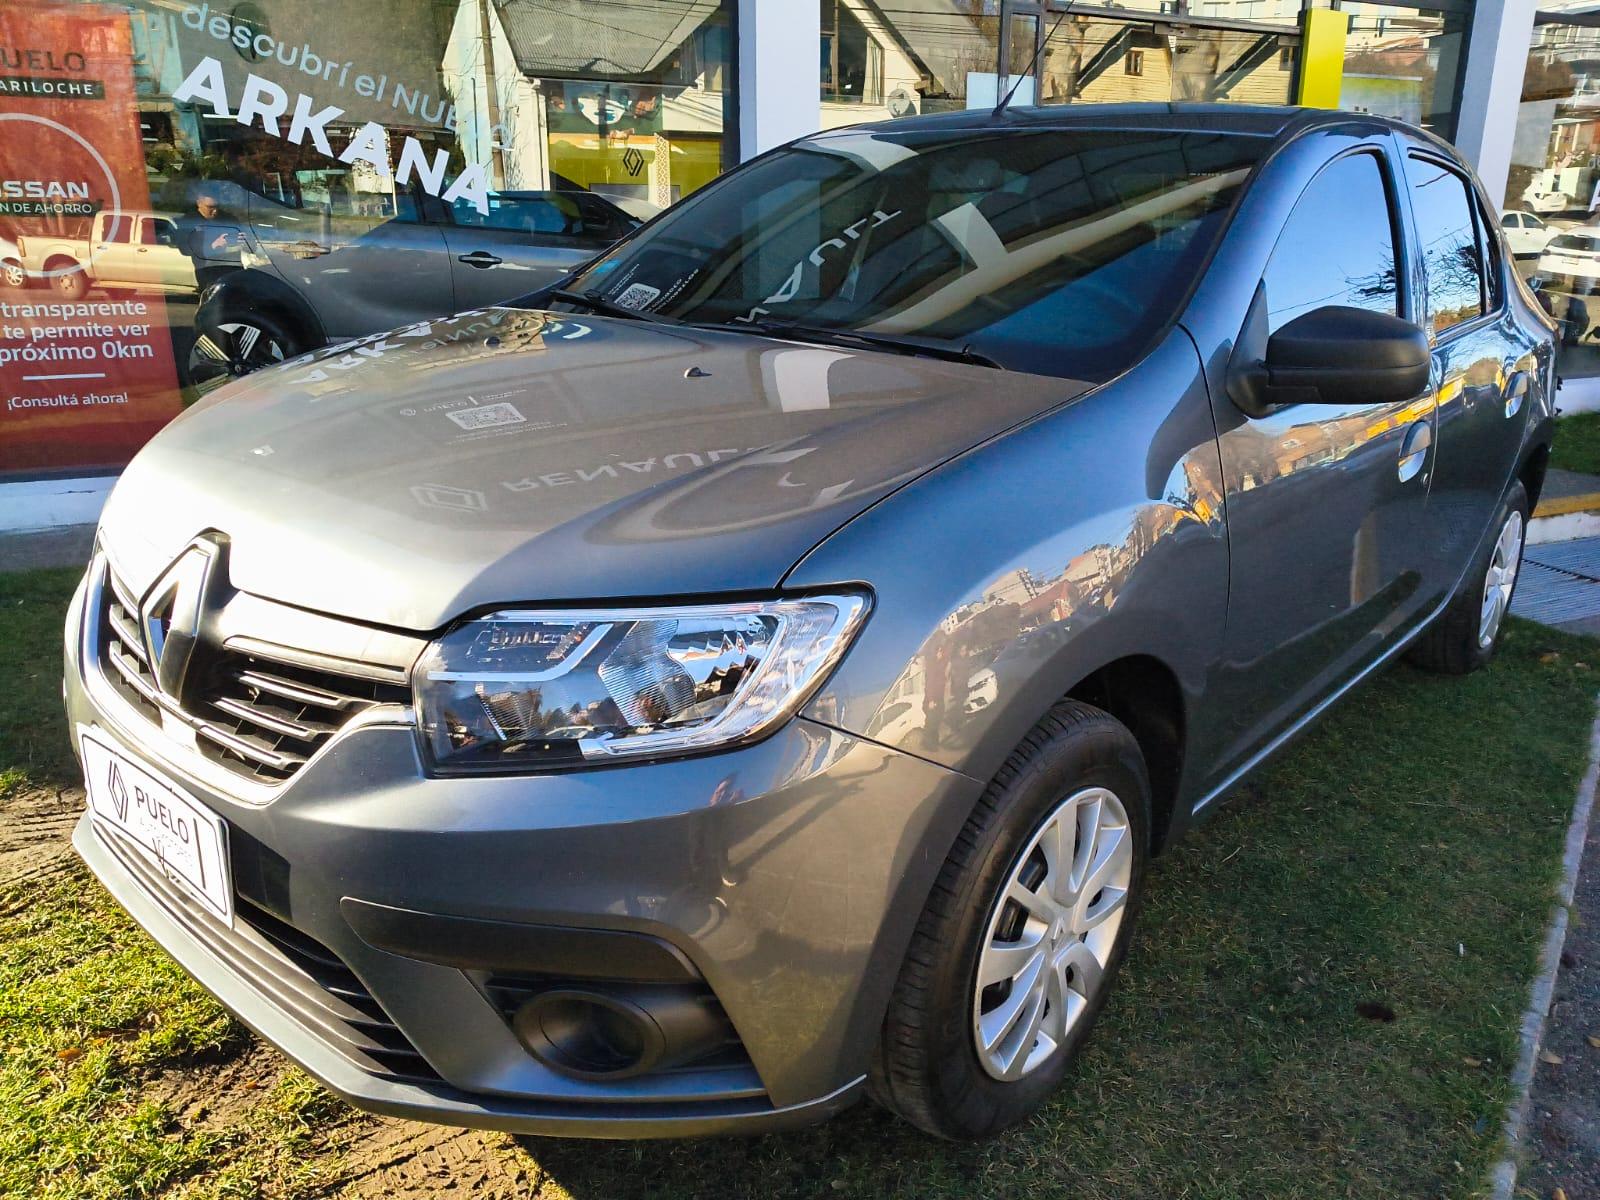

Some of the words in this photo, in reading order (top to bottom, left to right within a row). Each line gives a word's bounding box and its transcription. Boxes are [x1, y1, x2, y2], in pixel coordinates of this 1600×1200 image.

[181, 2, 353, 88] descubrí
[355, 74, 387, 102] el
[172, 56, 490, 216] ARKANA
[0, 180, 89, 198] SSAN
[13, 203, 32, 213] DE
[34, 203, 92, 213] AHORRO
[0, 300, 147, 321] transparente
[3, 323, 25, 339] te
[31, 322, 114, 343] permite
[118, 321, 150, 337] ver
[0, 342, 97, 367] próximo
[7, 393, 78, 411] ¡Consultá
[83, 392, 128, 405] ahora!
[134, 785, 190, 845] PUELO
